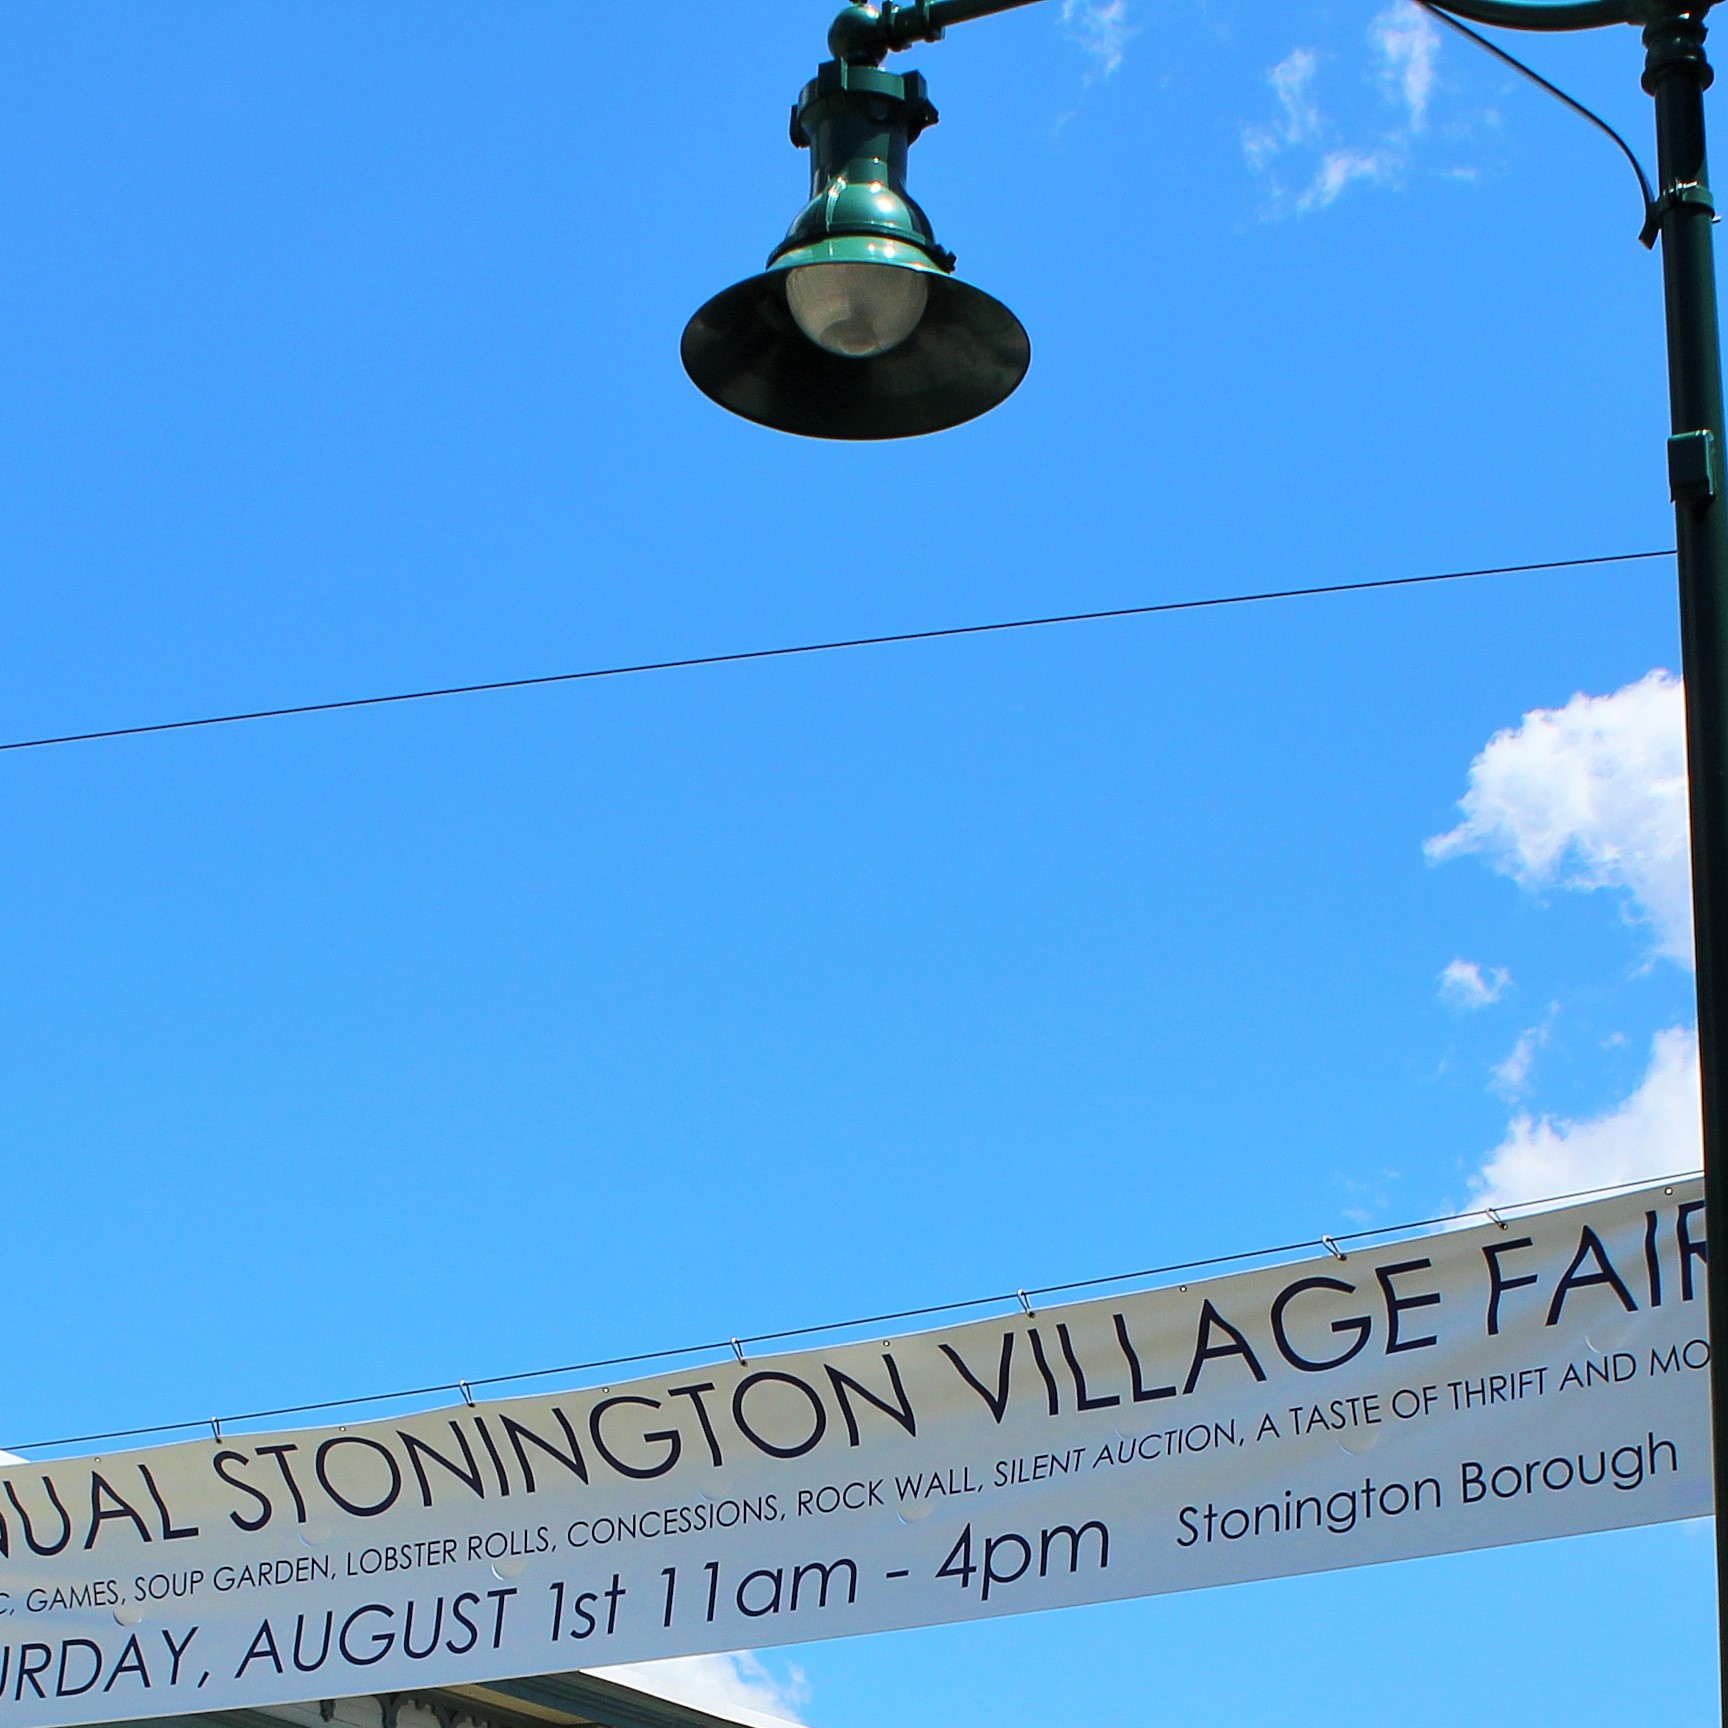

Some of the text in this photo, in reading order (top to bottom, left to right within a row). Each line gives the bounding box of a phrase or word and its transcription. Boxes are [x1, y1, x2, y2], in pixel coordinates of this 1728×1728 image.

[212, 1353, 917, 1532] STONINGTON
[937, 1257, 1442, 1425] VILLAGE
[1481, 1197, 1709, 1336] FAIR
[26, 1579, 127, 1613] GAMES,
[134, 1568, 206, 1602] SOUP
[213, 1554, 337, 1592] GARDEN,
[347, 1538, 458, 1576] LOBSTER
[467, 1526, 557, 1562] ROLLS,
[567, 1494, 786, 1548] CONCESSIONS,
[797, 1478, 885, 1517] ROCK
[894, 1466, 984, 1502] WALL,
[993, 1447, 1088, 1487] SILENT
[1092, 1418, 1245, 1469] AUCTION,
[1256, 1412, 1281, 1442] A
[1288, 1394, 1383, 1436] TASTE
[1391, 1384, 1439, 1419] OF
[1446, 1366, 1550, 1411] THRIFT
[1558, 1349, 1637, 1392] AND
[1649, 1339, 1711, 1377] MO
[1176, 1431, 1678, 1547] Stonington Borough
[233, 1587, 518, 1679] AUGUST
[549, 1573, 627, 1642] 1st
[660, 1558, 858, 1628] 11am
[934, 1520, 1109, 1602] 4pm
